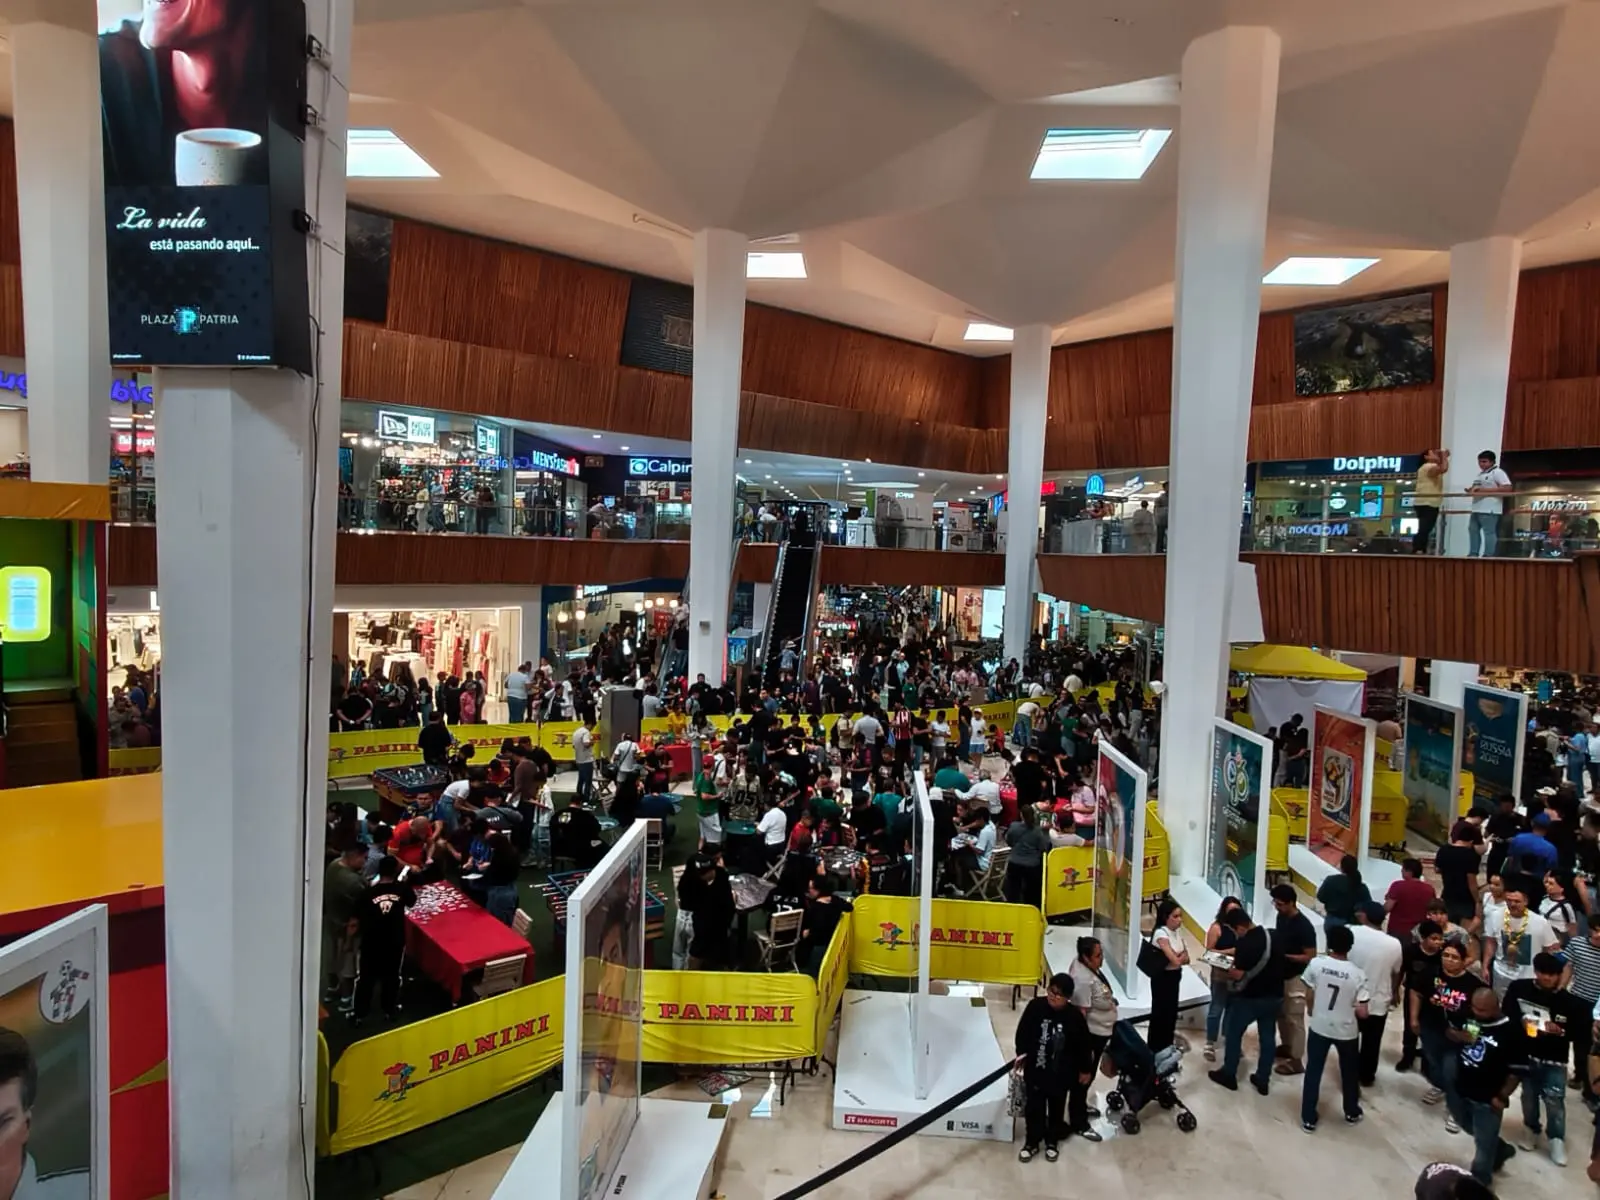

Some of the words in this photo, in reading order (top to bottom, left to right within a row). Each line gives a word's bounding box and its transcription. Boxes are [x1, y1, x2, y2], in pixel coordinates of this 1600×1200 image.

[116, 206, 153, 229] La
[157, 206, 207, 229] vida
[150, 238, 173, 250] está
[176, 238, 224, 252] pasando
[140, 314, 176, 325] PLAZA
[199, 314, 239, 325] PATRIA
[1333, 456, 1402, 473] Dolphy
[1480, 740, 1512, 758] RUSSIA
[1322, 967, 1349, 980] RONALDO
[1327, 983, 1340, 1011] 7
[658, 1003, 795, 1022] PANINI
[429, 1014, 550, 1073] PANINI
[857, 1117, 896, 1126] BANORTE
[961, 1121, 980, 1129] VISA
